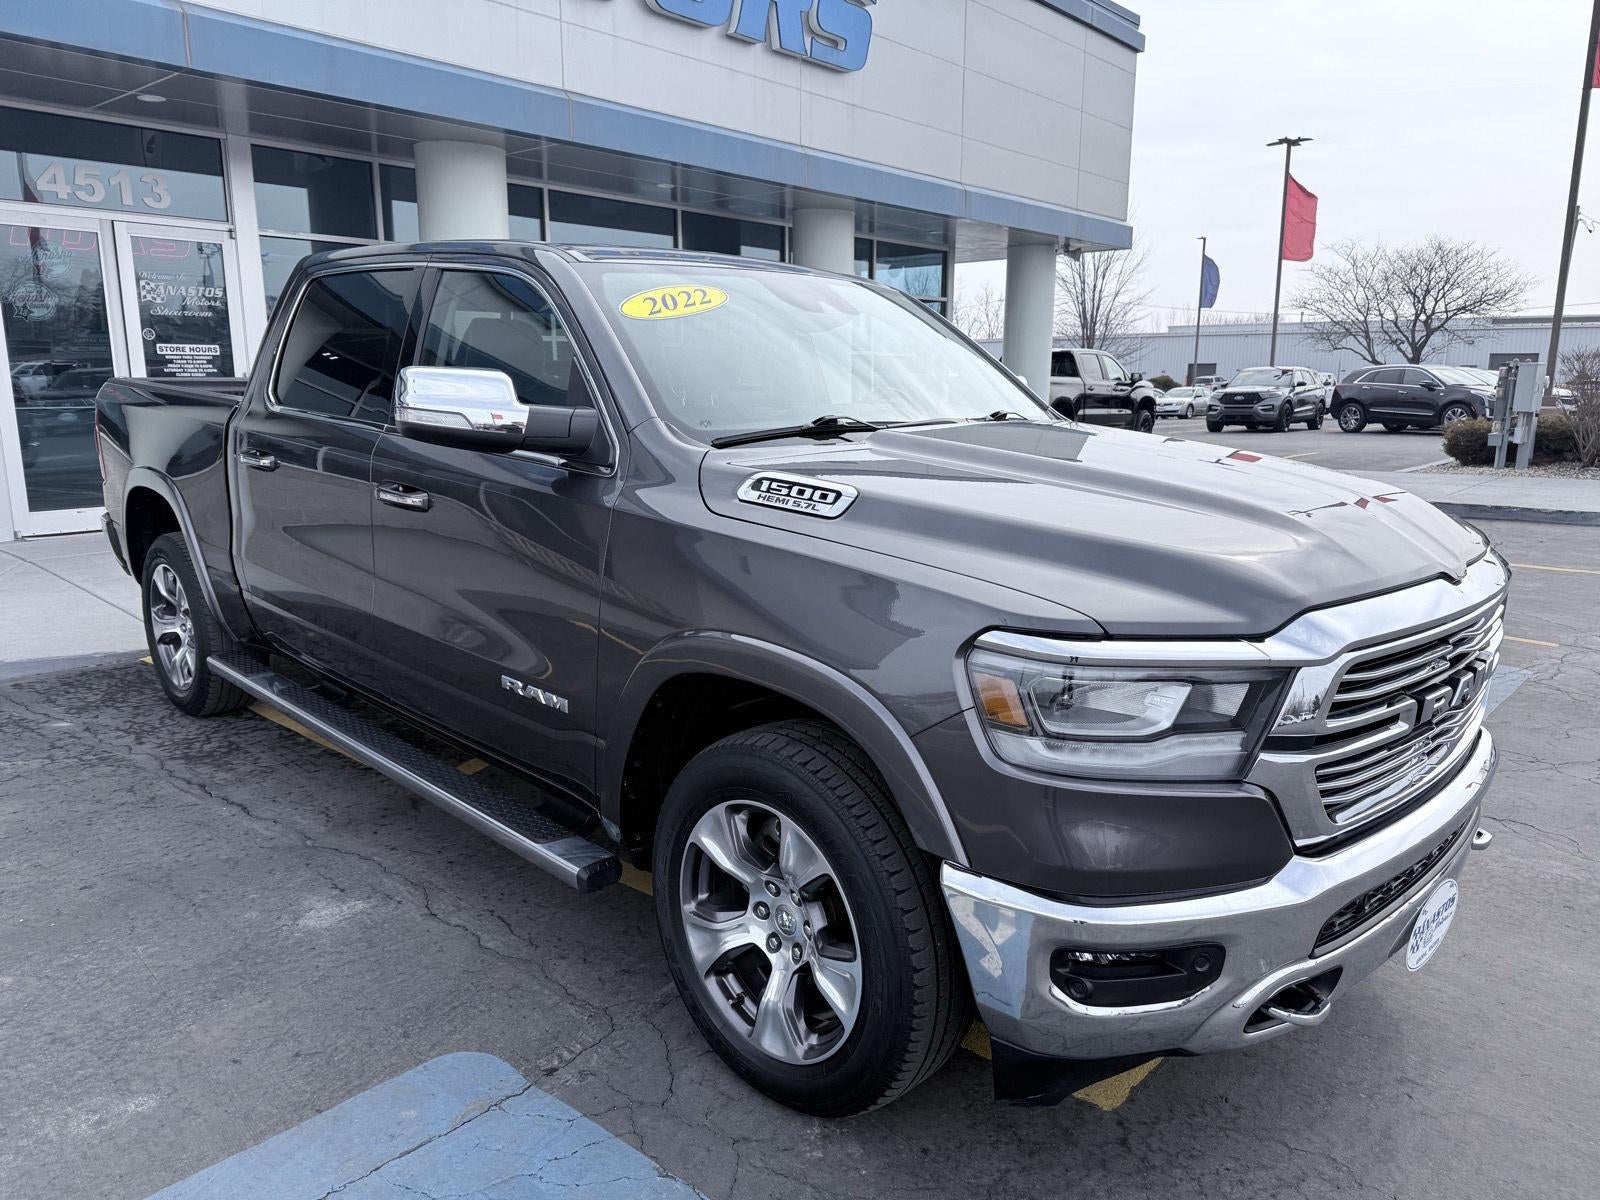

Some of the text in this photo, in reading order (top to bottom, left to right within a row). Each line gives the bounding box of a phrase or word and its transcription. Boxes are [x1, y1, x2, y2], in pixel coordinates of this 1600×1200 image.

[36, 161, 172, 209] 4513
[154, 283, 224, 298] ANASTOS
[150, 306, 213, 318] Showroom
[182, 297, 222, 307] Motors
[642, 288, 712, 316] 2022
[189, 346, 218, 354] HOURS
[757, 493, 820, 512] HEMI 5.7L
[759, 480, 837, 504] 1500
[501, 674, 568, 713] RAM
[1420, 650, 1495, 724] RAM
